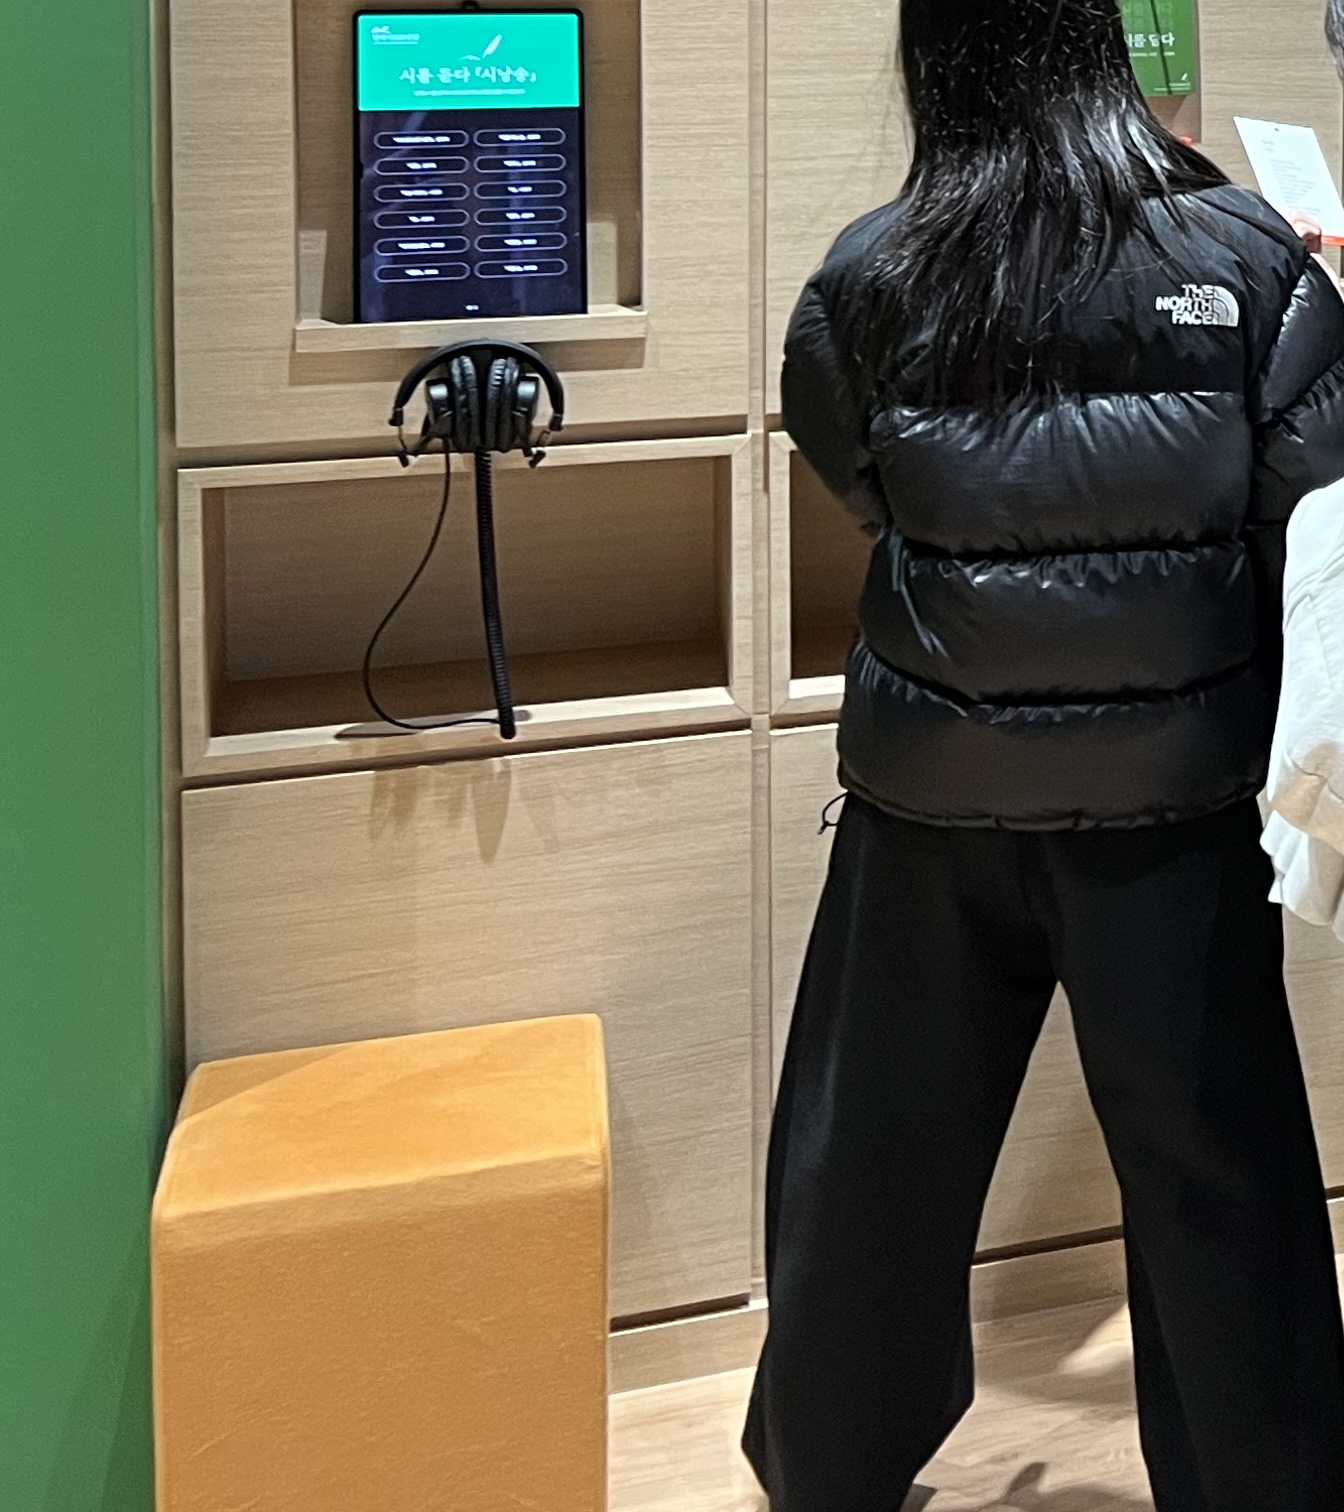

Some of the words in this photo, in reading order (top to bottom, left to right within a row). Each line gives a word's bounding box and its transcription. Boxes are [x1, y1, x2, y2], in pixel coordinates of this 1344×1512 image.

[399, 67, 434, 84] 시를
[1181, 284, 1214, 299] THE
[1155, 295, 1213, 311] NORTH
[1172, 310, 1215, 325] FACE
